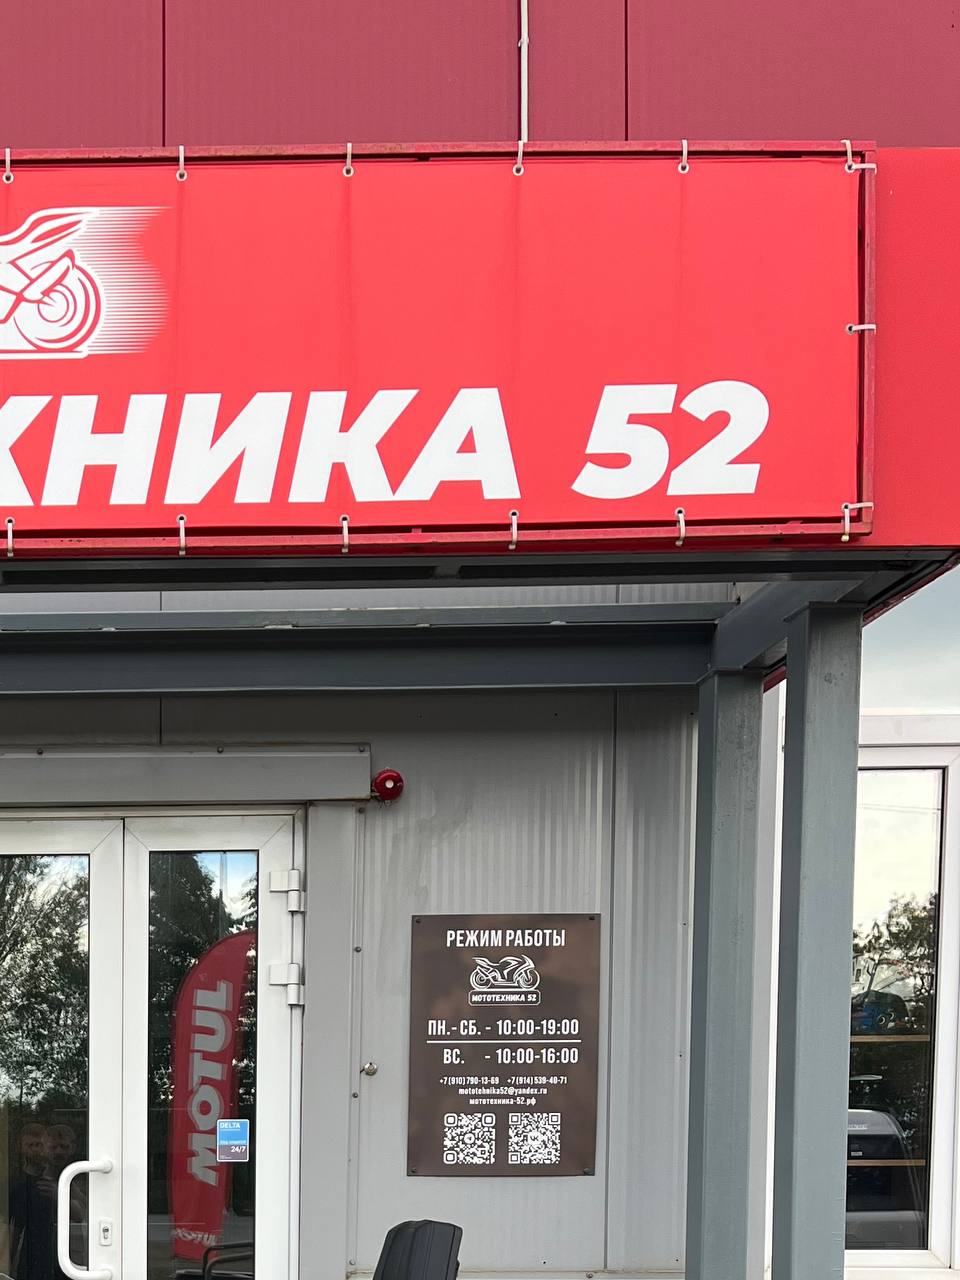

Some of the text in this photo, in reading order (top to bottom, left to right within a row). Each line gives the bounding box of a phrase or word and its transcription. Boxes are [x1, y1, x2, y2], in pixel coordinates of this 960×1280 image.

[571, 380, 770, 499] 52
[446, 929, 566, 947] РЕЖИМ РАБОТЫ
[471, 993, 537, 1002] МОТОТЕХНИКА 52
[496, 1019, 579, 1035] 10:00-19:00
[443, 1048, 465, 1064] ВС.
[495, 1048, 579, 1064] 10:00-16:00
[188, 980, 231, 1187] MOTUL
[219, 1121, 241, 1129] DELTA
[230, 1145, 247, 1154] 24/7
